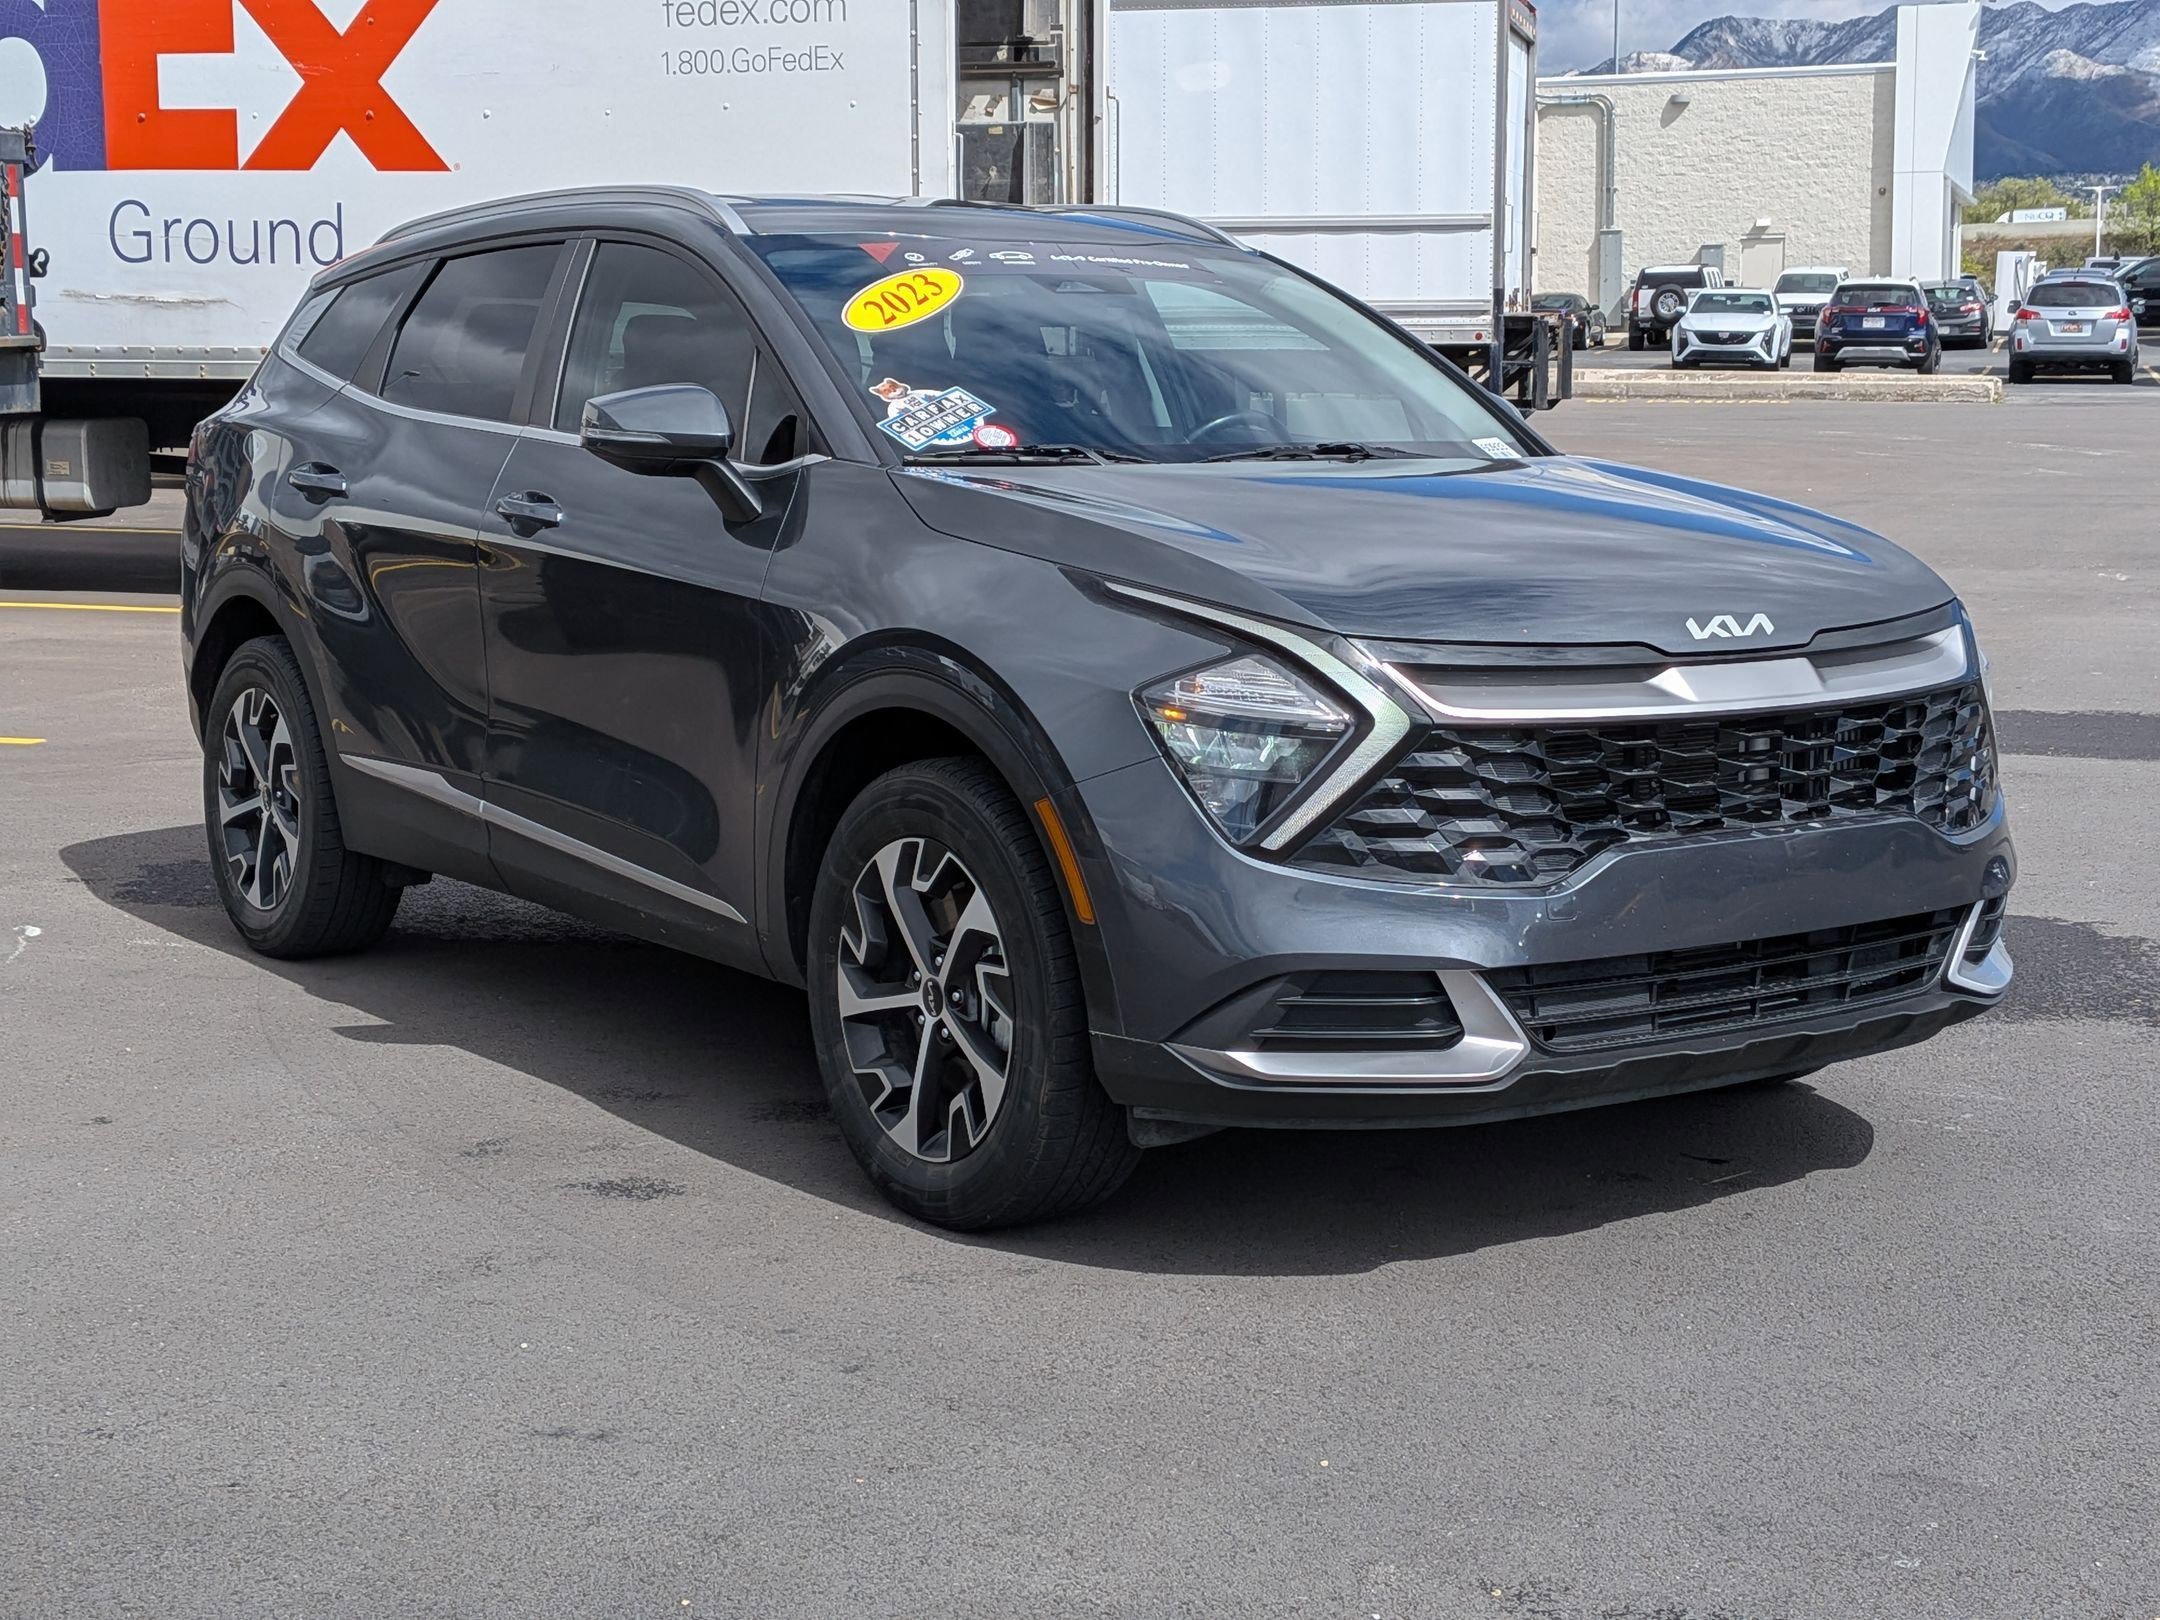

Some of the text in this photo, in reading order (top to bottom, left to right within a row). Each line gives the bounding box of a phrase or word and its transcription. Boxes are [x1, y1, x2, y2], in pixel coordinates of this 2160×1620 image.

[661, 0, 847, 28] fedex.com
[660, 45, 845, 76] 1.800.GoFedEx
[108, 199, 345, 266] Ground
[862, 274, 943, 325] 2023
[890, 394, 970, 433] CARFAX
[1686, 613, 1774, 640] KIA
